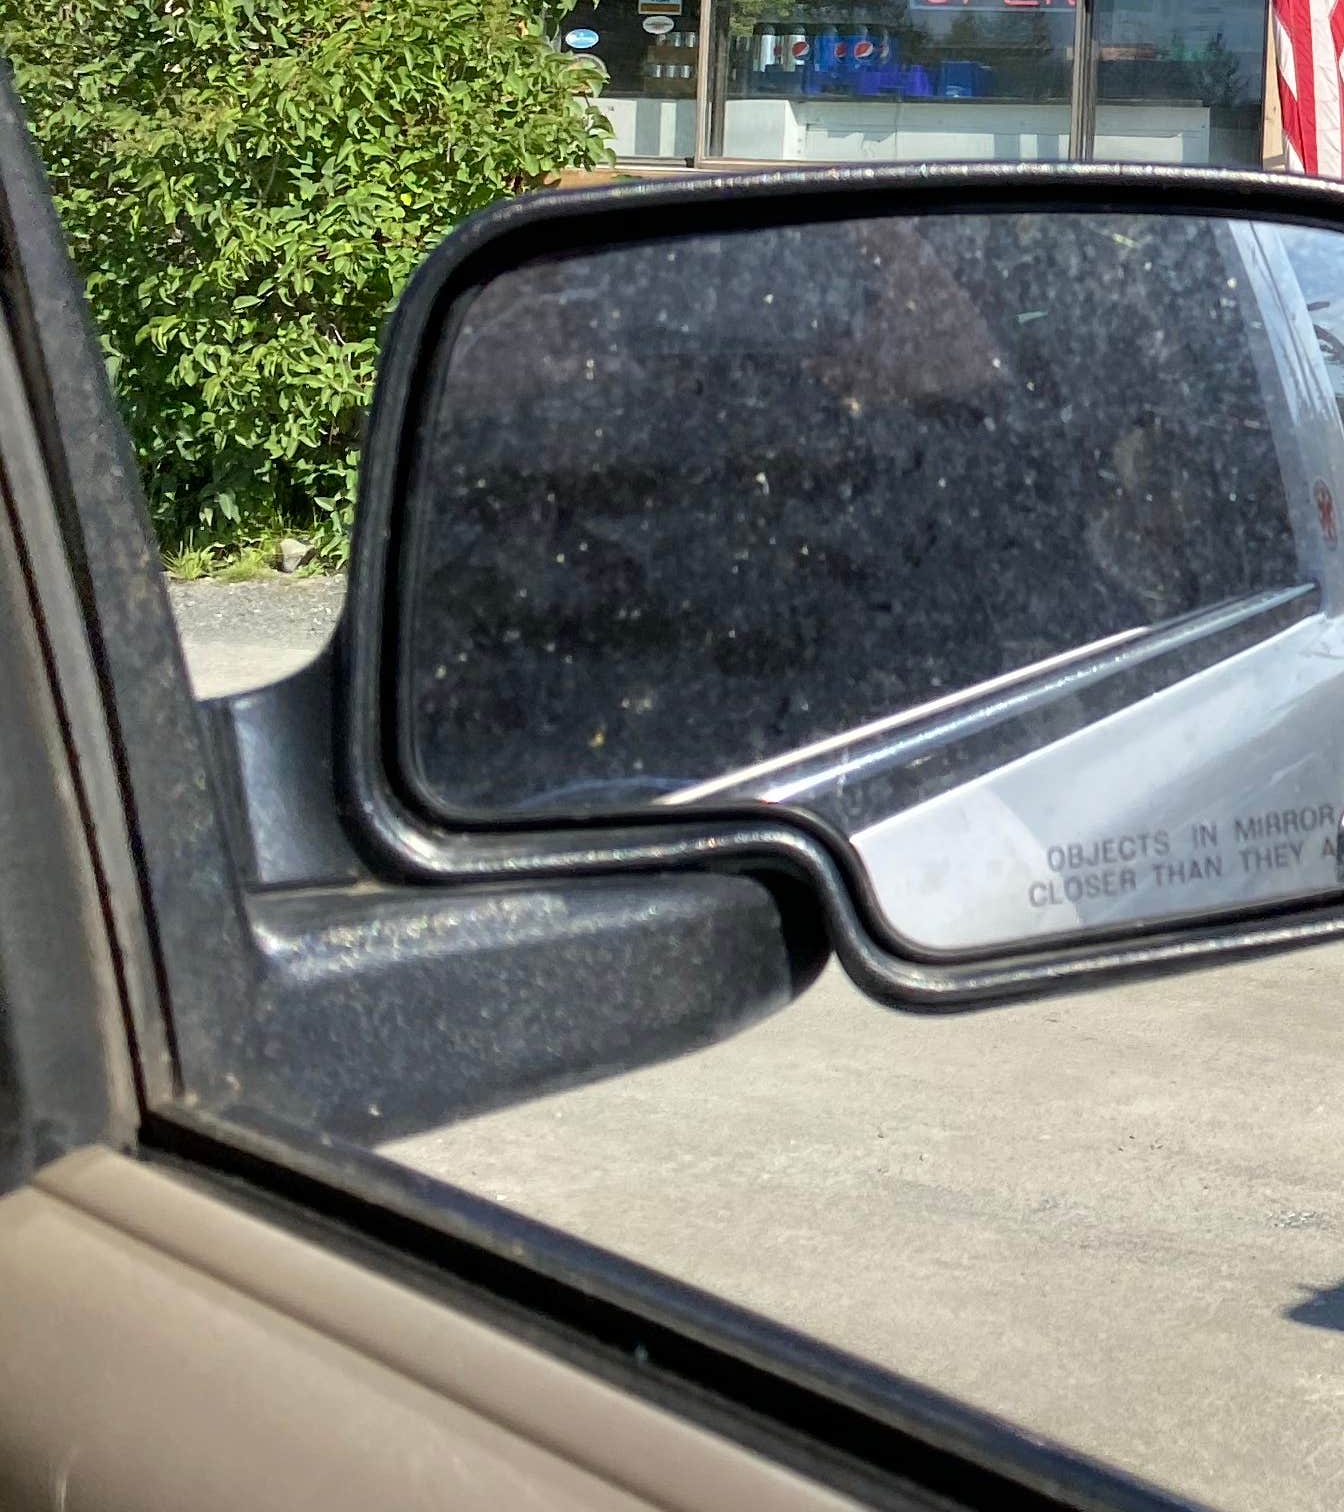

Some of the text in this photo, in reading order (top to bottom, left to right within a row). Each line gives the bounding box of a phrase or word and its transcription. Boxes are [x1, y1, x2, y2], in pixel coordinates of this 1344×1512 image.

[1028, 866, 1138, 909] CLOSER
[1152, 853, 1223, 888] THAN
[1240, 837, 1304, 870] THEY
[1046, 830, 1171, 873] OBJECTS
[1191, 823, 1218, 849] IN
[1233, 804, 1336, 840] MIRROR
